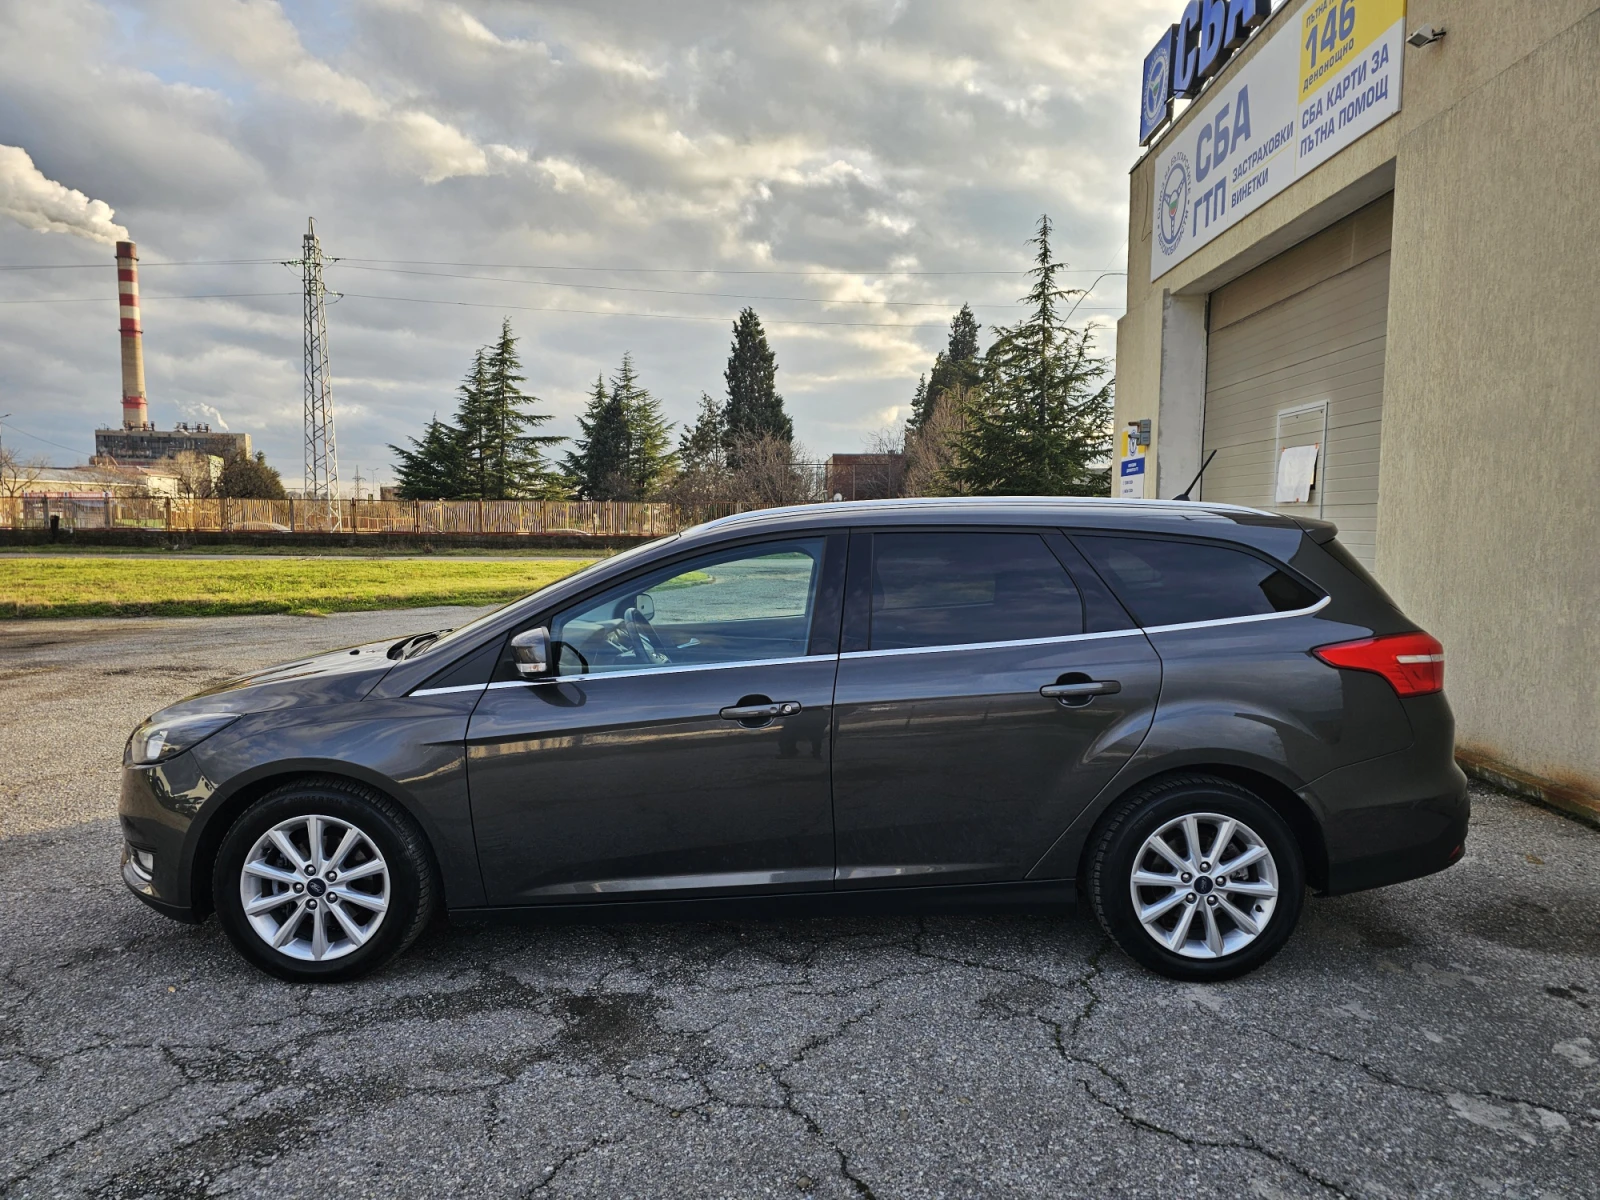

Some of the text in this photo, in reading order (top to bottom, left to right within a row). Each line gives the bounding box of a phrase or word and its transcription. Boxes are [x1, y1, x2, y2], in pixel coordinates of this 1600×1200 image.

[1305, 0, 1356, 69] 146
[1300, 74, 1388, 158] ПЪТНА ПОМОЩ
[1302, 43, 1389, 130] СБА КАРТИ ЗА
[1195, 84, 1251, 183] СБА
[1232, 120, 1294, 183] ЗАСТРАХОВКИ
[1192, 176, 1227, 238] ГТП
[1231, 167, 1269, 209] ВИНЕТКИ
